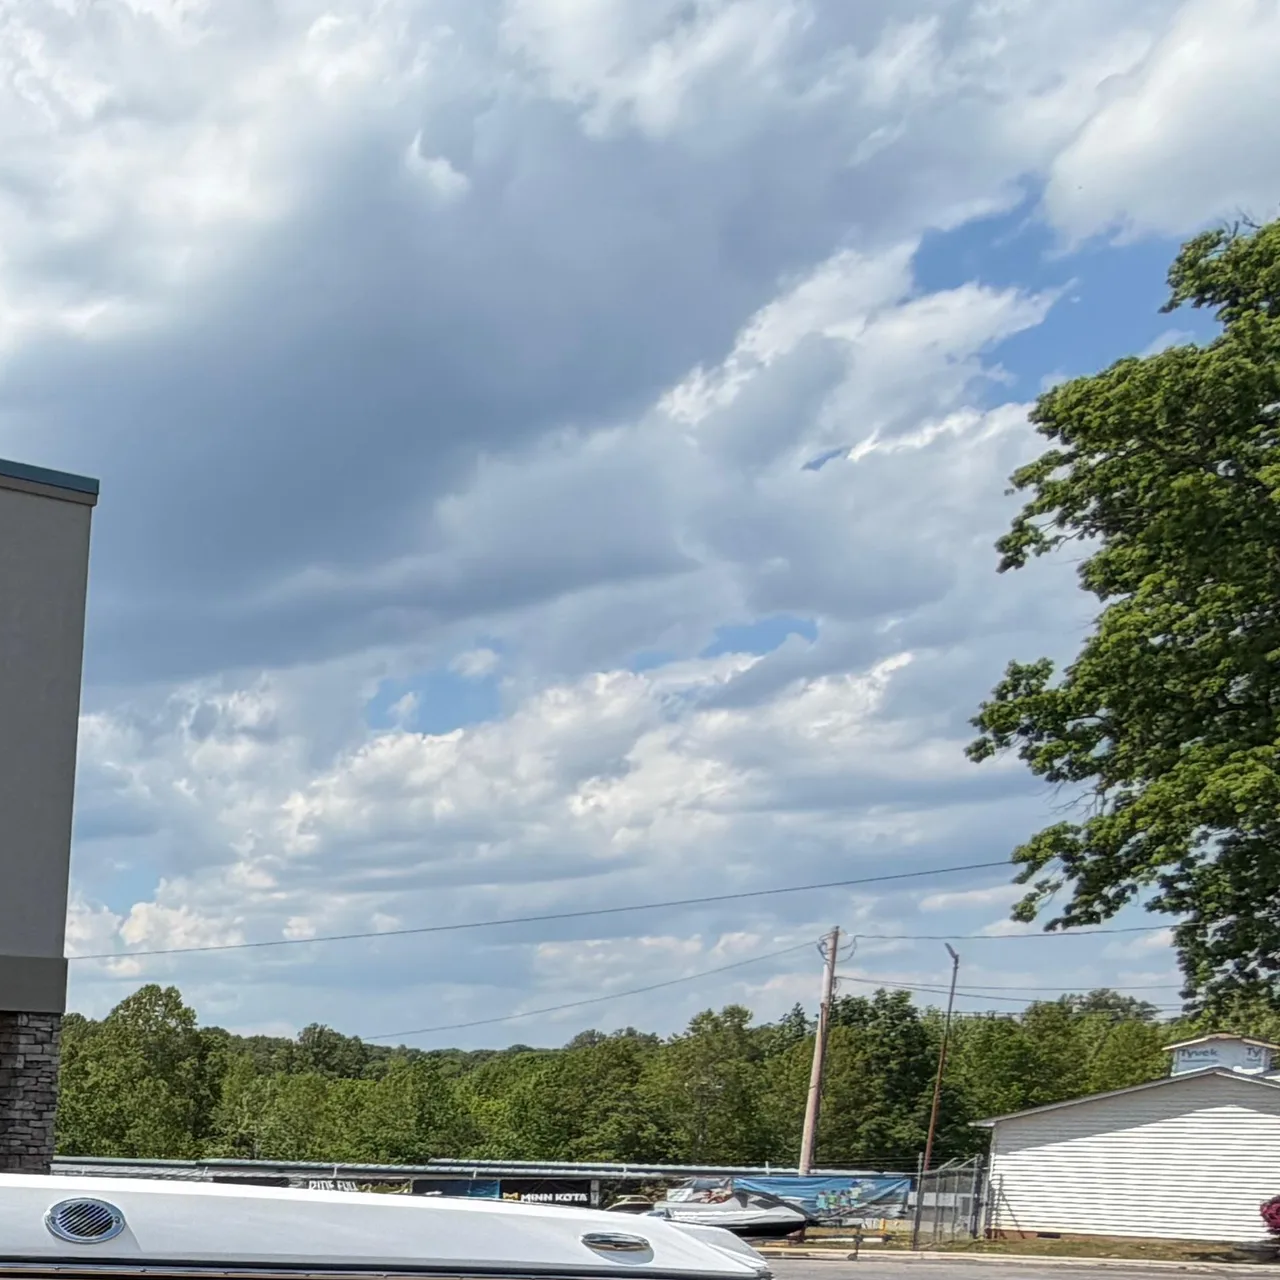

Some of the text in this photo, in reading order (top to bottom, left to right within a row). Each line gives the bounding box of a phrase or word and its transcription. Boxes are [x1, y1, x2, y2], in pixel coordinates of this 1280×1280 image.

[1180, 1048, 1218, 1058] Tyvek
[521, 1193, 587, 1203] MINN KOTA
